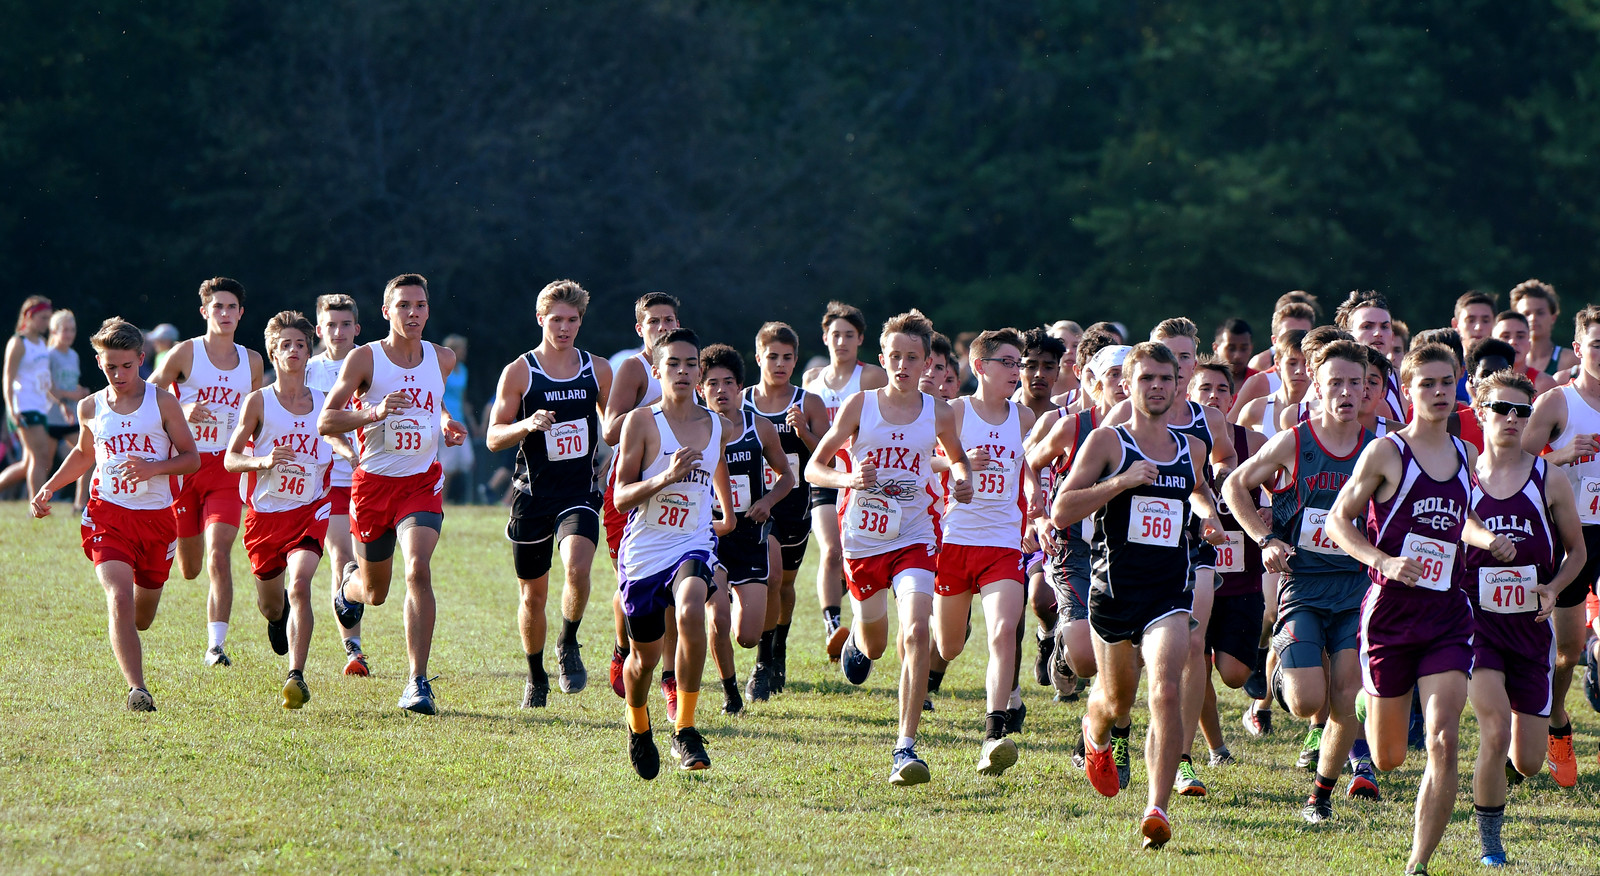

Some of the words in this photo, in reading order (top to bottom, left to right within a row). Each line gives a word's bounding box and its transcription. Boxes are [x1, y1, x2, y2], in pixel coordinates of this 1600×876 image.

[196, 386, 241, 410] NIXA
[383, 387, 434, 414] XA
[544, 389, 587, 401] WILLARD
[194, 426, 218, 442] 344
[395, 432, 421, 450] 333
[104, 433, 156, 459] NIXA
[556, 435, 582, 455] 570
[726, 450, 751, 463] LARD
[278, 475, 305, 495] 346
[978, 474, 1005, 494] 353
[1151, 474, 1186, 489] LLARD
[1304, 471, 1350, 493] WOLV
[658, 505, 689, 528] 287
[859, 510, 888, 534] 338
[1141, 515, 1172, 539] 569
[1483, 515, 1534, 536] OLLA
[1493, 585, 1525, 607] 470
